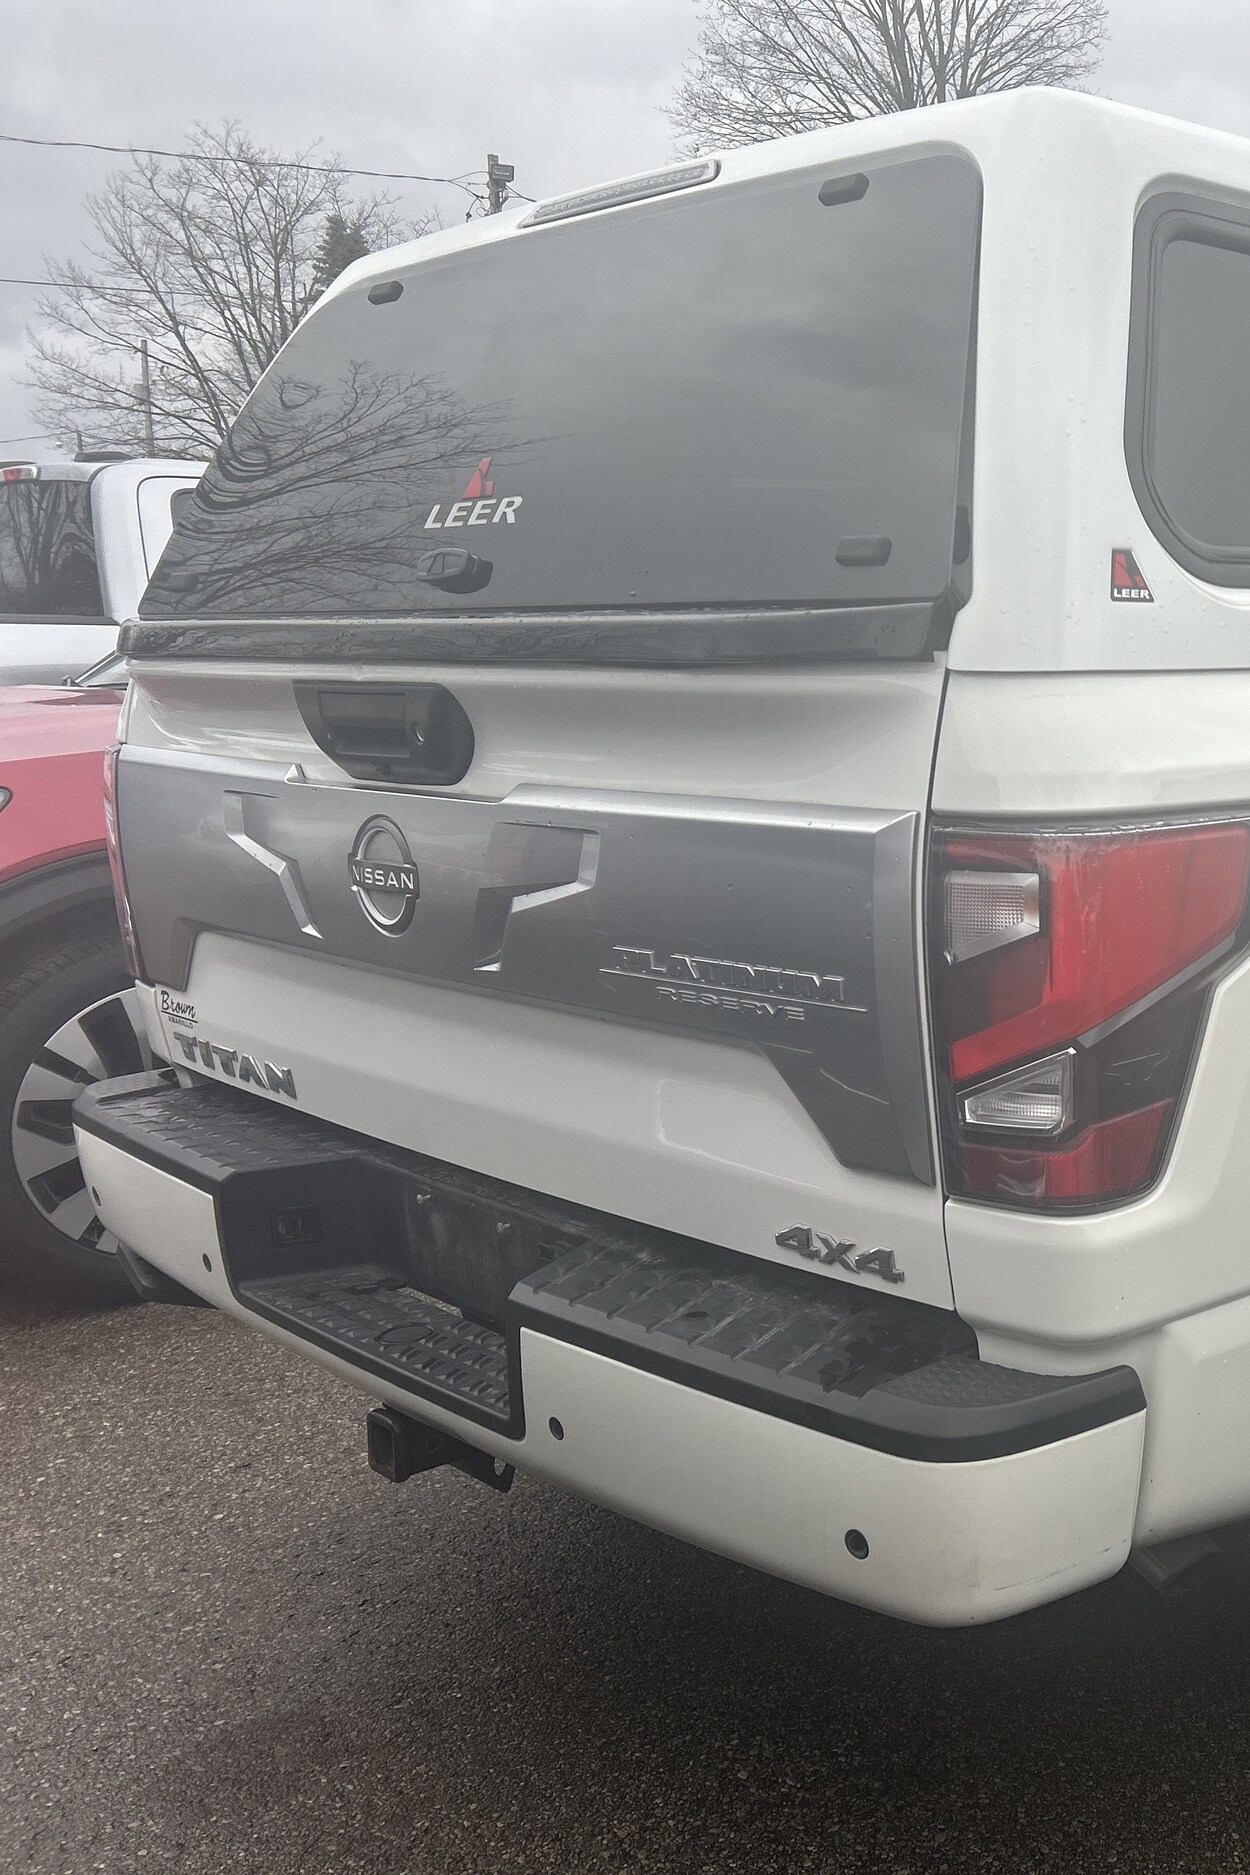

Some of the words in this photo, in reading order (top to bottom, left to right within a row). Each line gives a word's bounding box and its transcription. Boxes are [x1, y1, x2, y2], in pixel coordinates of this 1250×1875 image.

[424, 496, 523, 529] LEER
[1113, 588, 1151, 600] LEER
[352, 864, 414, 890] NISSAN
[611, 945, 845, 1003] PLATINUM
[160, 989, 196, 1019] Brown
[656, 986, 805, 1021] RESERVE
[173, 1031, 297, 1100] TITAN
